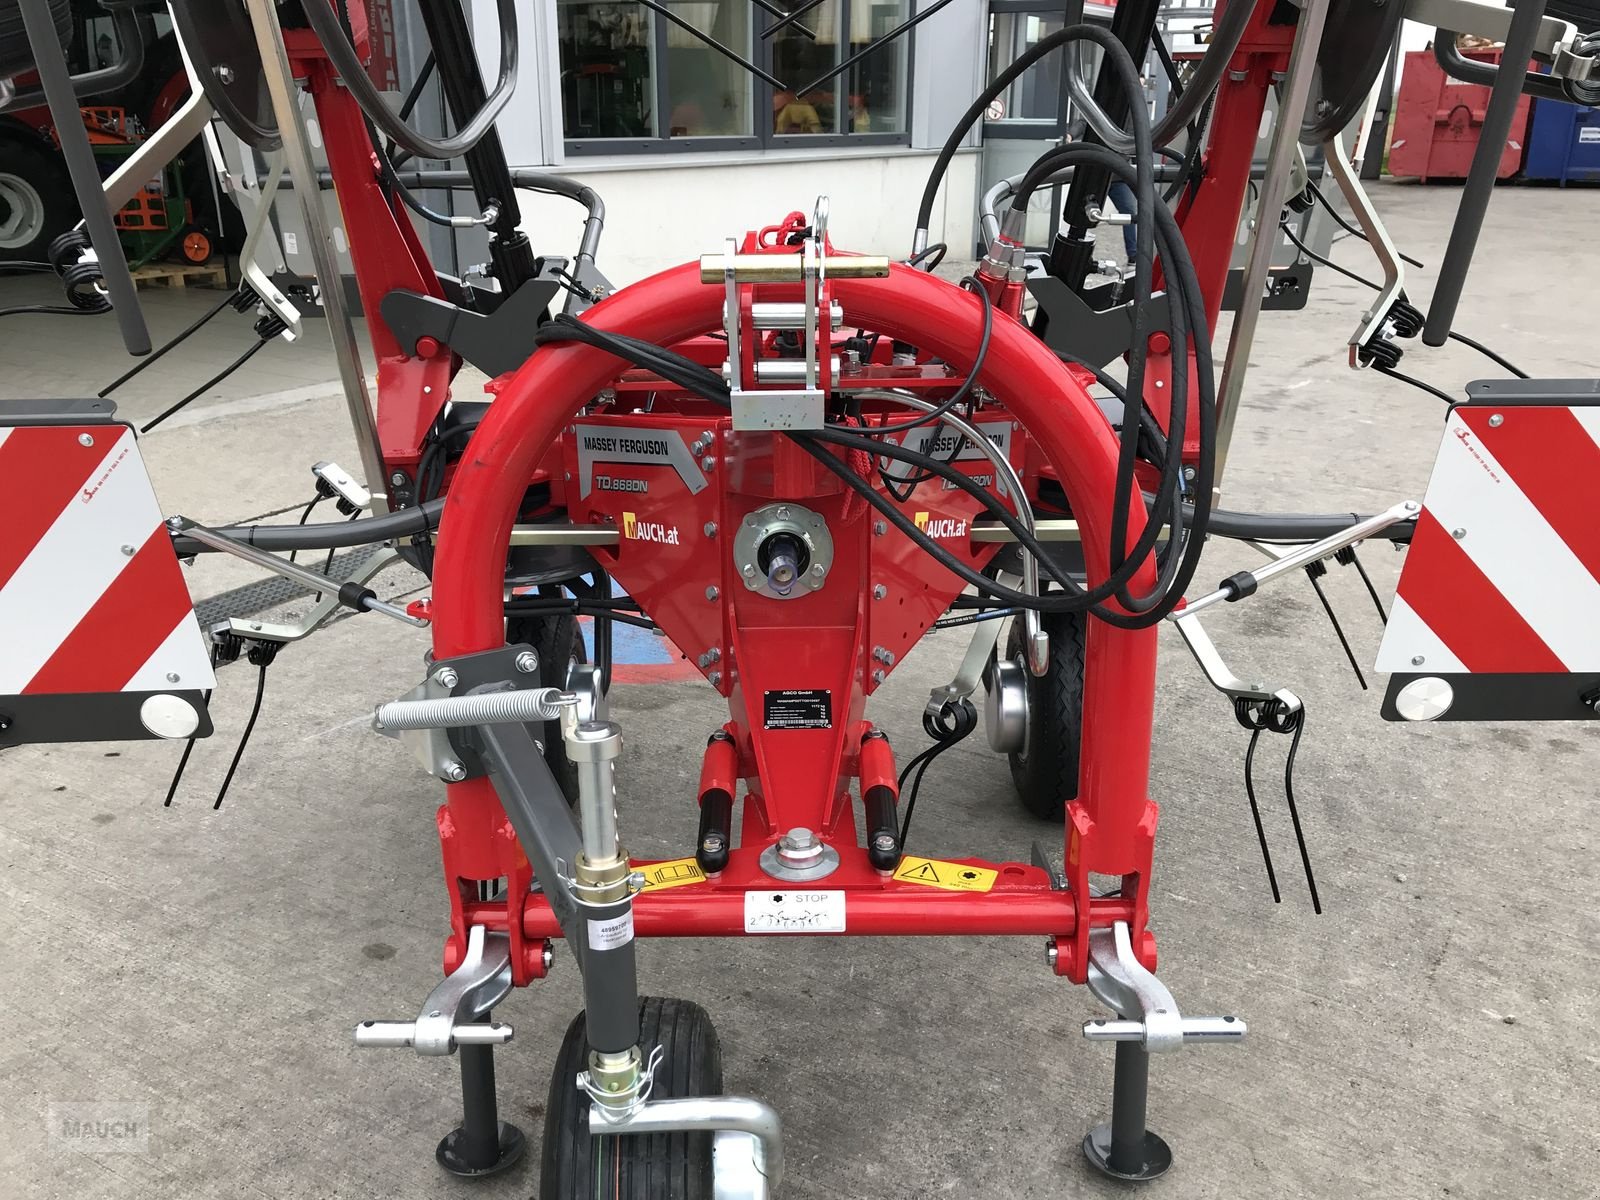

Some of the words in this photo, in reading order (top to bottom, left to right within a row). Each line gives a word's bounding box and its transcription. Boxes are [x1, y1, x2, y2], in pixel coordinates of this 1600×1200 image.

[584, 437, 617, 452] MASSEY
[620, 439, 669, 456] FERGUSON
[596, 475, 648, 494] TD.868DN
[626, 520, 680, 545] MAUCH.at
[795, 894, 829, 903] STOP
